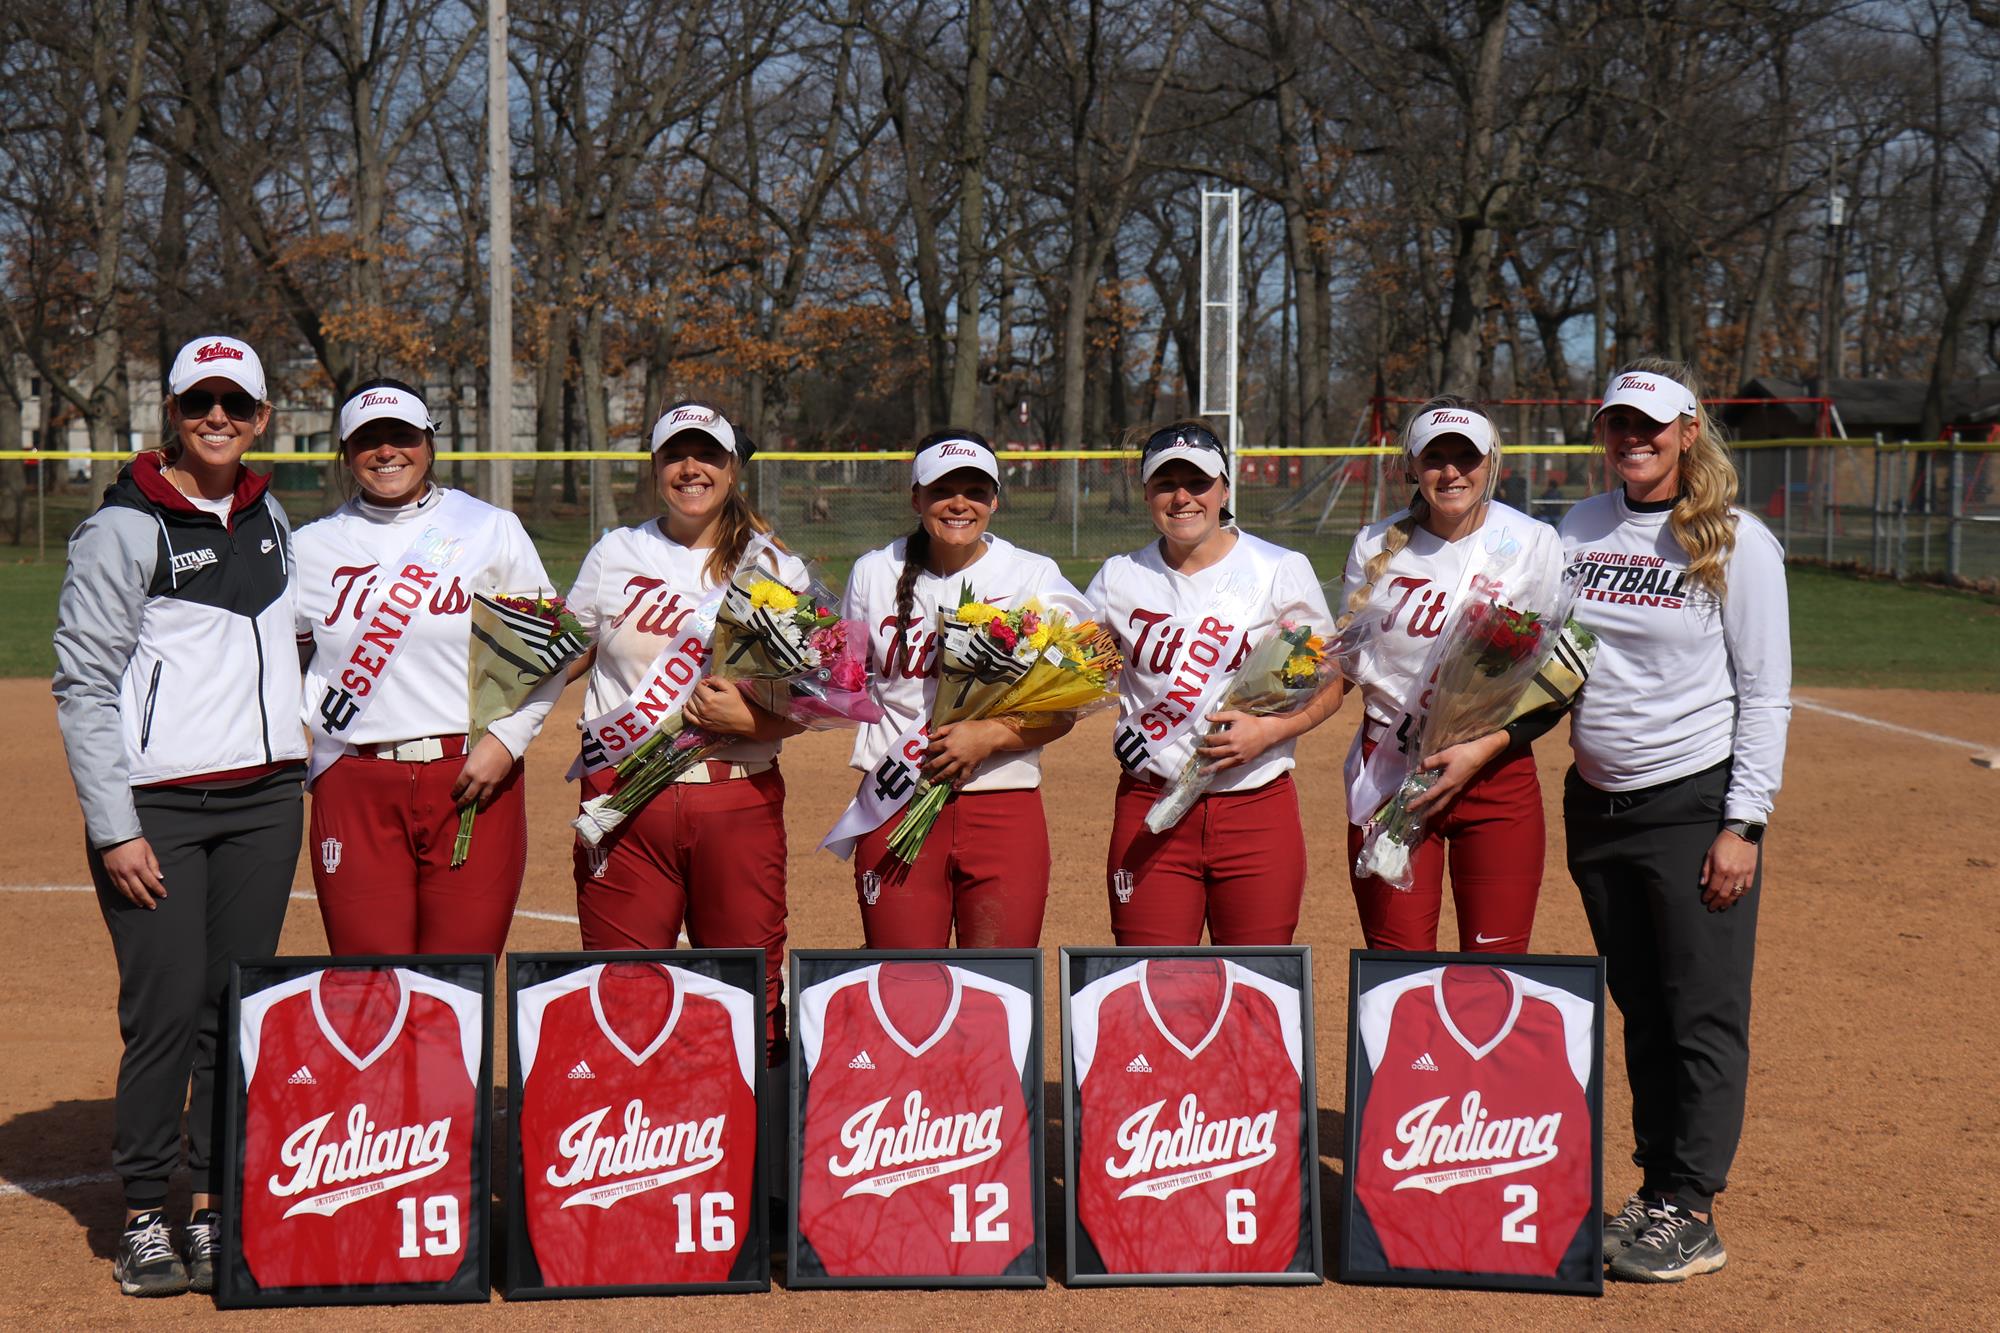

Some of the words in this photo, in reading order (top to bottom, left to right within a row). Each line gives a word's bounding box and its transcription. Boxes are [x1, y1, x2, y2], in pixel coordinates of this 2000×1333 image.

[194, 342, 244, 363] Indiana
[1617, 375, 1656, 392] Titans
[360, 391, 399, 410] Titans
[670, 408, 711, 425] Titans
[1430, 410, 1470, 426] Titans
[938, 442, 977, 458] Titans
[169, 548, 217, 569] TITANS
[1586, 551, 1628, 566] SOUTH
[1629, 554, 1667, 568] BEND
[1584, 588, 1684, 609] TITANS
[341, 564, 438, 697] SENIOR
[1140, 616, 1235, 741] SENIOR
[599, 637, 713, 752] SENIOR
[828, 1089, 1004, 1177] Indiana
[1105, 1093, 1278, 1178] Indiana
[1382, 1090, 1562, 1171] Indiana
[269, 1103, 452, 1197] Indiana
[546, 1098, 726, 1188] Indiana
[873, 1173, 906, 1187] UNIVERSITY
[906, 1168, 925, 1180] SOUTH
[1147, 1179, 1180, 1192] UNIVERSITY
[1180, 1174, 1199, 1186] SOUTH
[1424, 1171, 1458, 1184] UNIVERSITY
[1458, 1168, 1477, 1179] SOUTH
[314, 1190, 349, 1207] UNIVERSITY
[350, 1185, 370, 1198] SOUTH
[590, 1187, 624, 1201] UNIVERSITY
[624, 1182, 644, 1193] SOUTH
[672, 1191, 736, 1253] 16
[948, 1182, 1010, 1243] 12
[1225, 1188, 1257, 1245] 6
[1502, 1184, 1538, 1243] 2
[397, 1195, 461, 1259] 19
